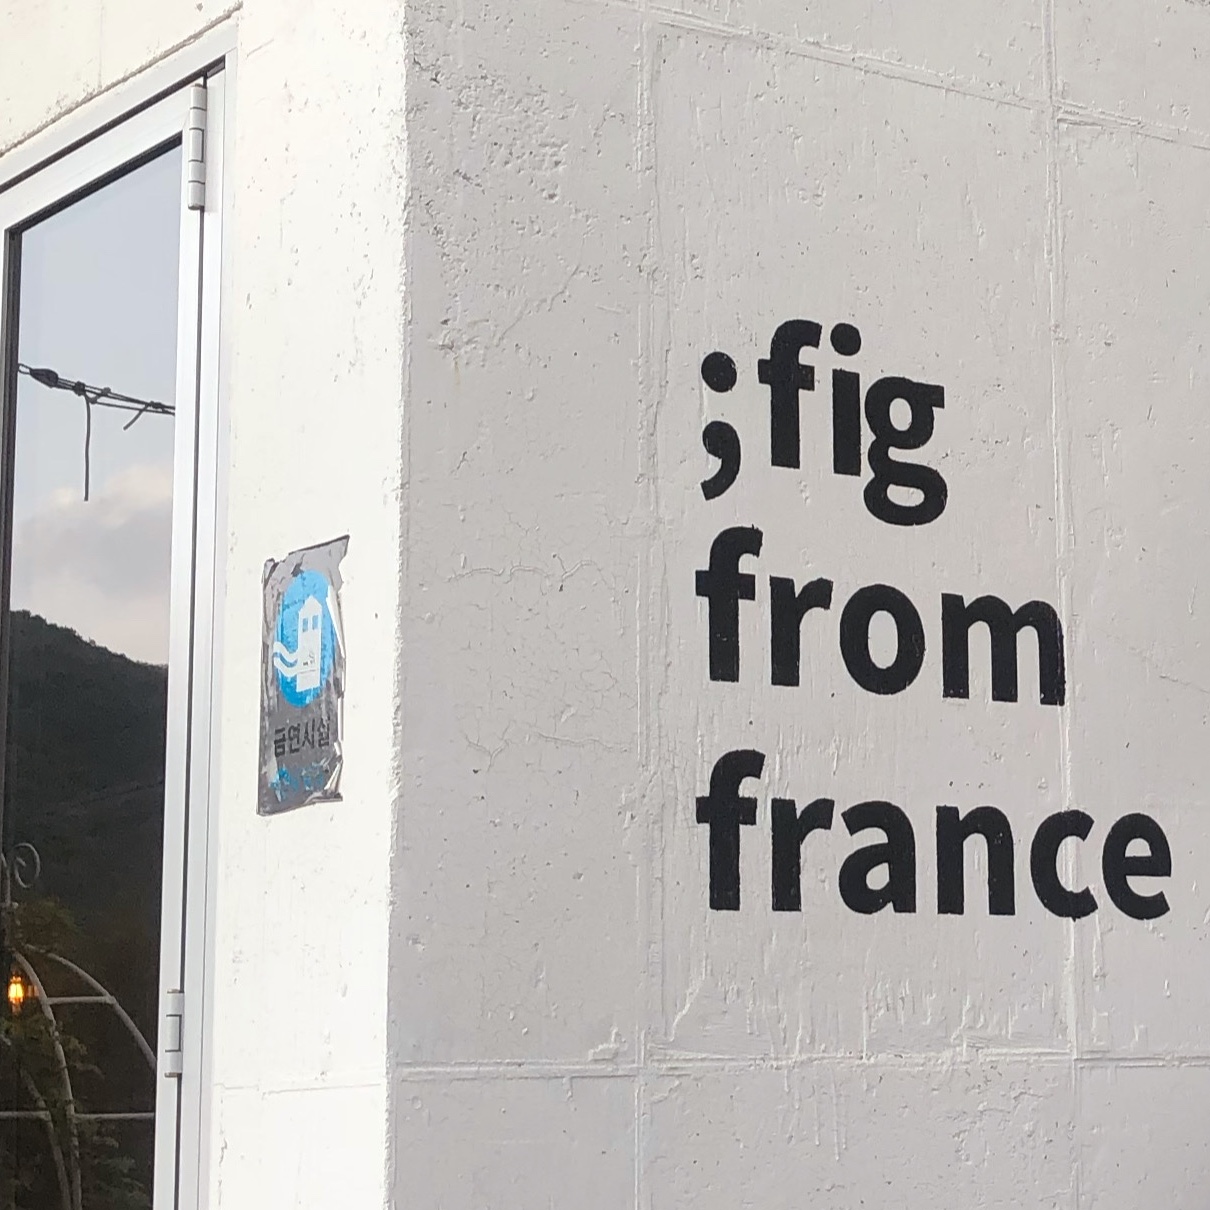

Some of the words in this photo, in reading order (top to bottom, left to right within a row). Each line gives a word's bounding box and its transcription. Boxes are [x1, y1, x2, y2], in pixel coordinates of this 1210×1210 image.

[700, 319, 948, 527] ;fig
[695, 526, 1067, 706] from
[695, 749, 1172, 922] france
